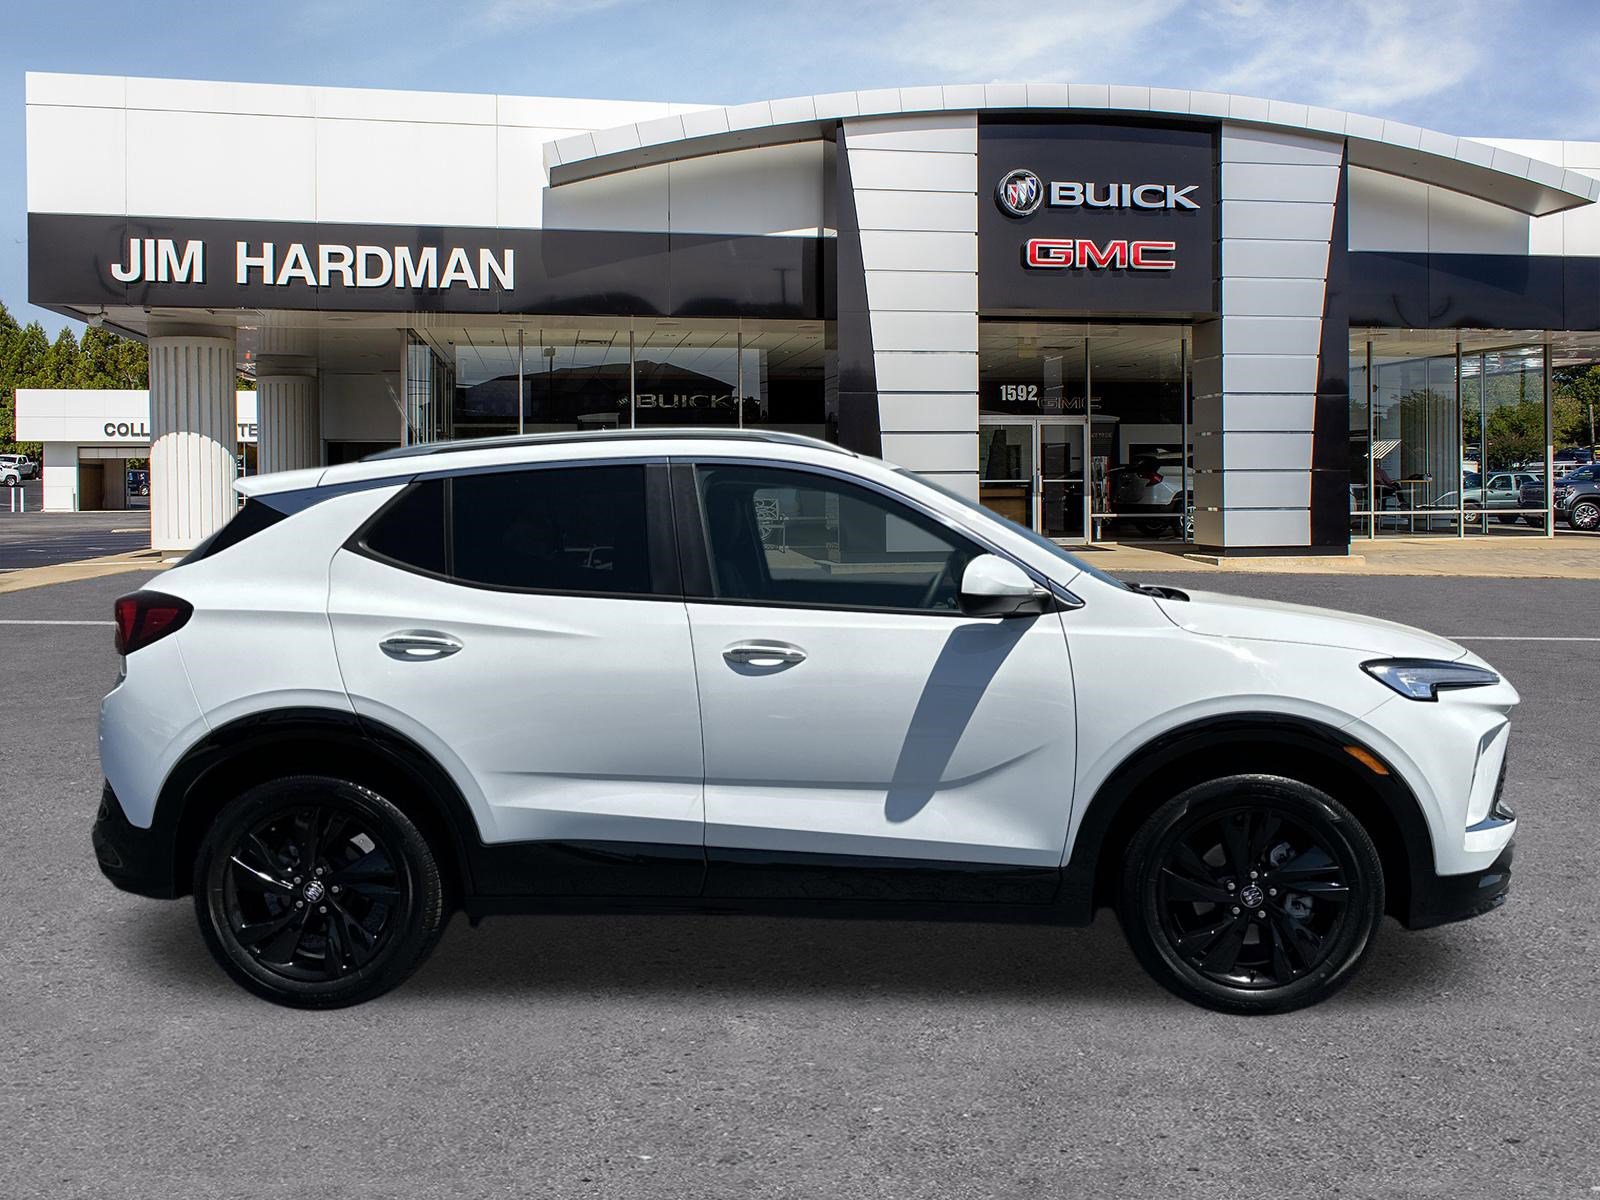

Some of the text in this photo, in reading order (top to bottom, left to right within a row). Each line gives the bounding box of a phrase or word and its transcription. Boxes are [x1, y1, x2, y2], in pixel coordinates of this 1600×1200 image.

[1049, 181, 1200, 210] BUICK
[110, 238, 515, 291] JIM HARDMAN
[1025, 238, 1177, 271] GMC
[636, 393, 732, 409] BUICK
[1000, 384, 1038, 401] 1592
[1037, 396, 1102, 409] GMC
